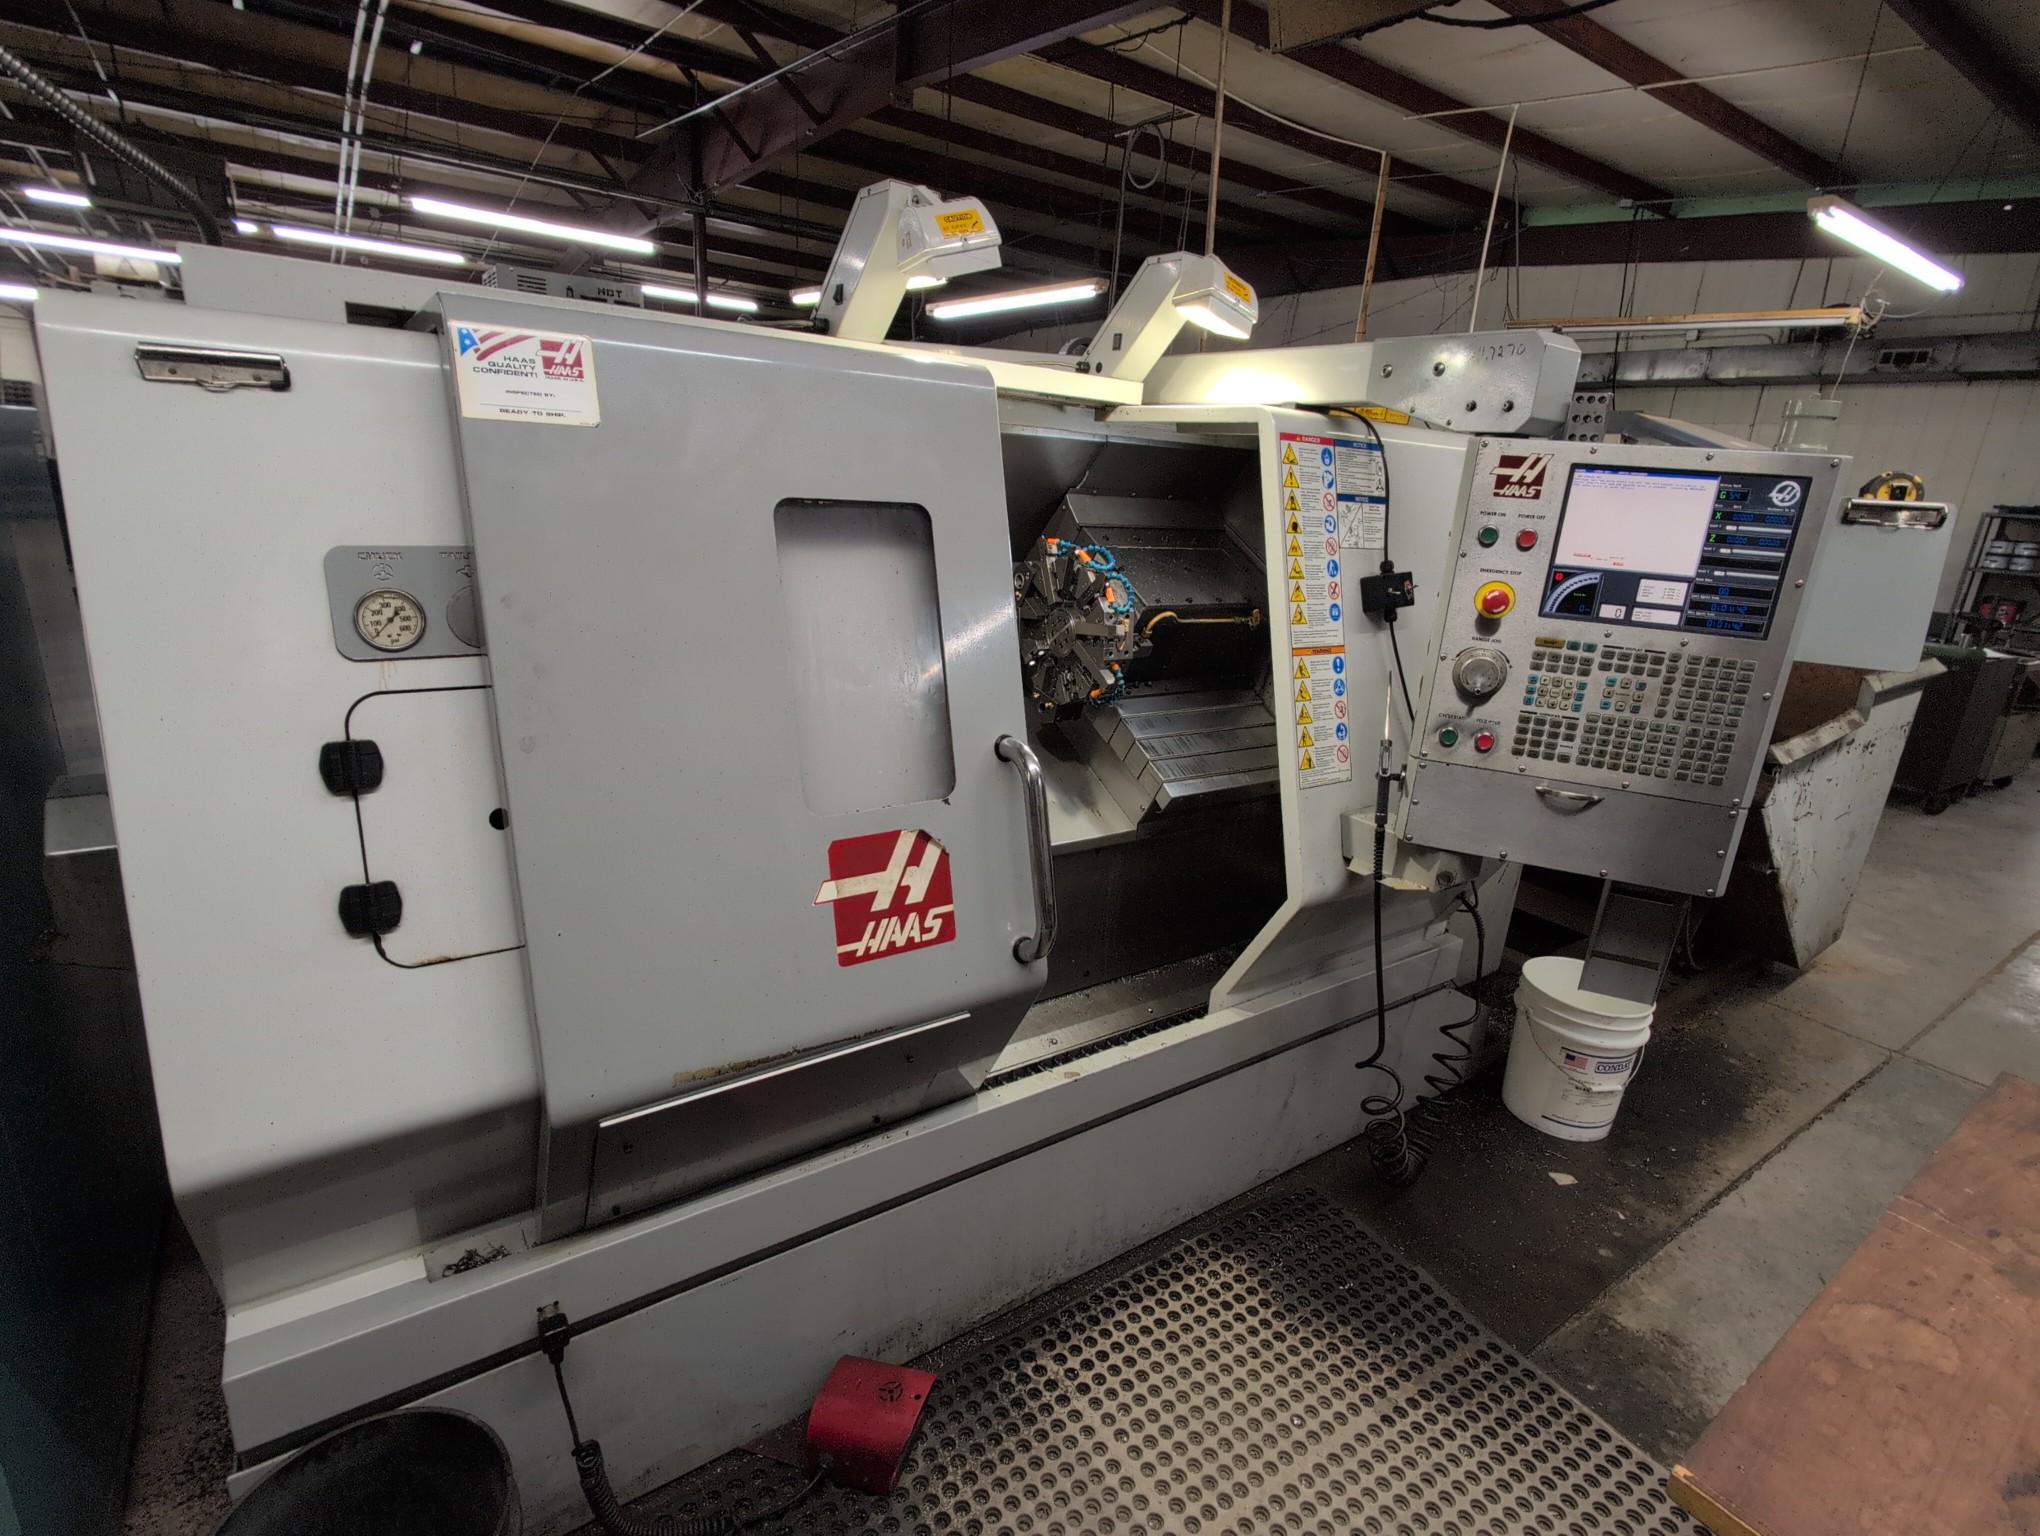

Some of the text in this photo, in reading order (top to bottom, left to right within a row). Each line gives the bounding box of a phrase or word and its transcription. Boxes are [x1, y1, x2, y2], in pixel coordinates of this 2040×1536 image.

[503, 355, 537, 365] HAAS
[472, 366, 539, 379] CONFIDENT!
[487, 361, 537, 372] QUALITY
[548, 364, 582, 377] HAAS
[1493, 484, 1543, 498] HAAS
[1714, 511, 1722, 519] X
[1709, 534, 1717, 543] Z
[837, 904, 954, 957] HAAS
